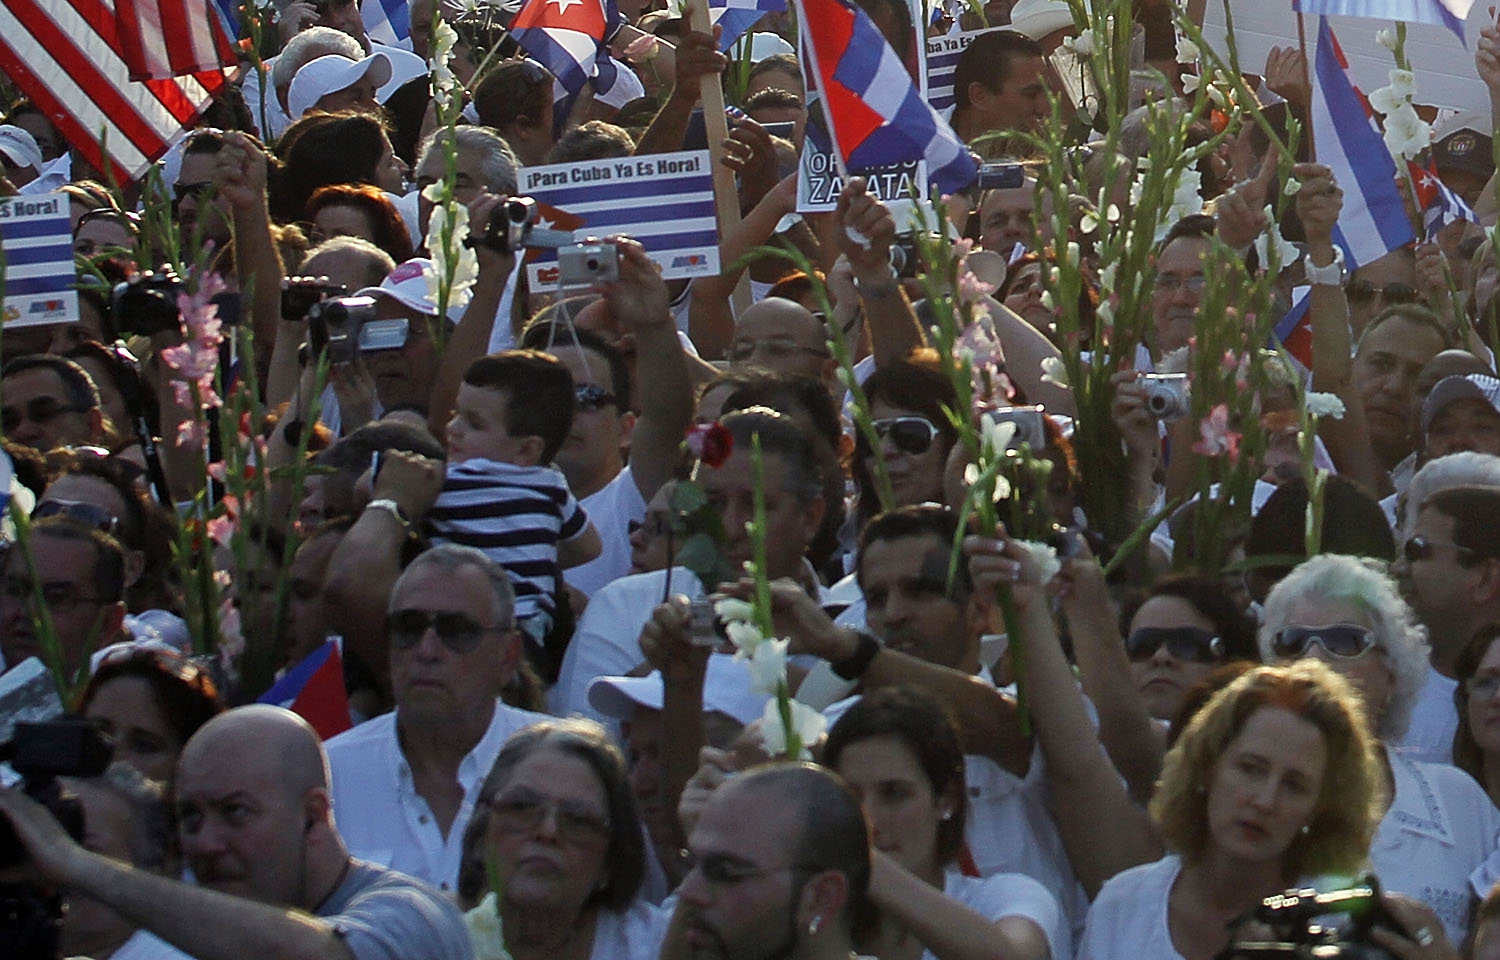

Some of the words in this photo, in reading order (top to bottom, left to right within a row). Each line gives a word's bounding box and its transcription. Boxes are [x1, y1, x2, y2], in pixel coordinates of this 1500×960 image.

[944, 38, 959, 51] Ya
[527, 170, 568, 189] ¡Para
[571, 166, 612, 183] Cuba
[614, 162, 633, 179] Ya
[637, 160, 654, 176] Es
[657, 155, 701, 174] Hora!
[808, 172, 912, 204] ZAATA
[15, 199, 59, 216] Hora!
